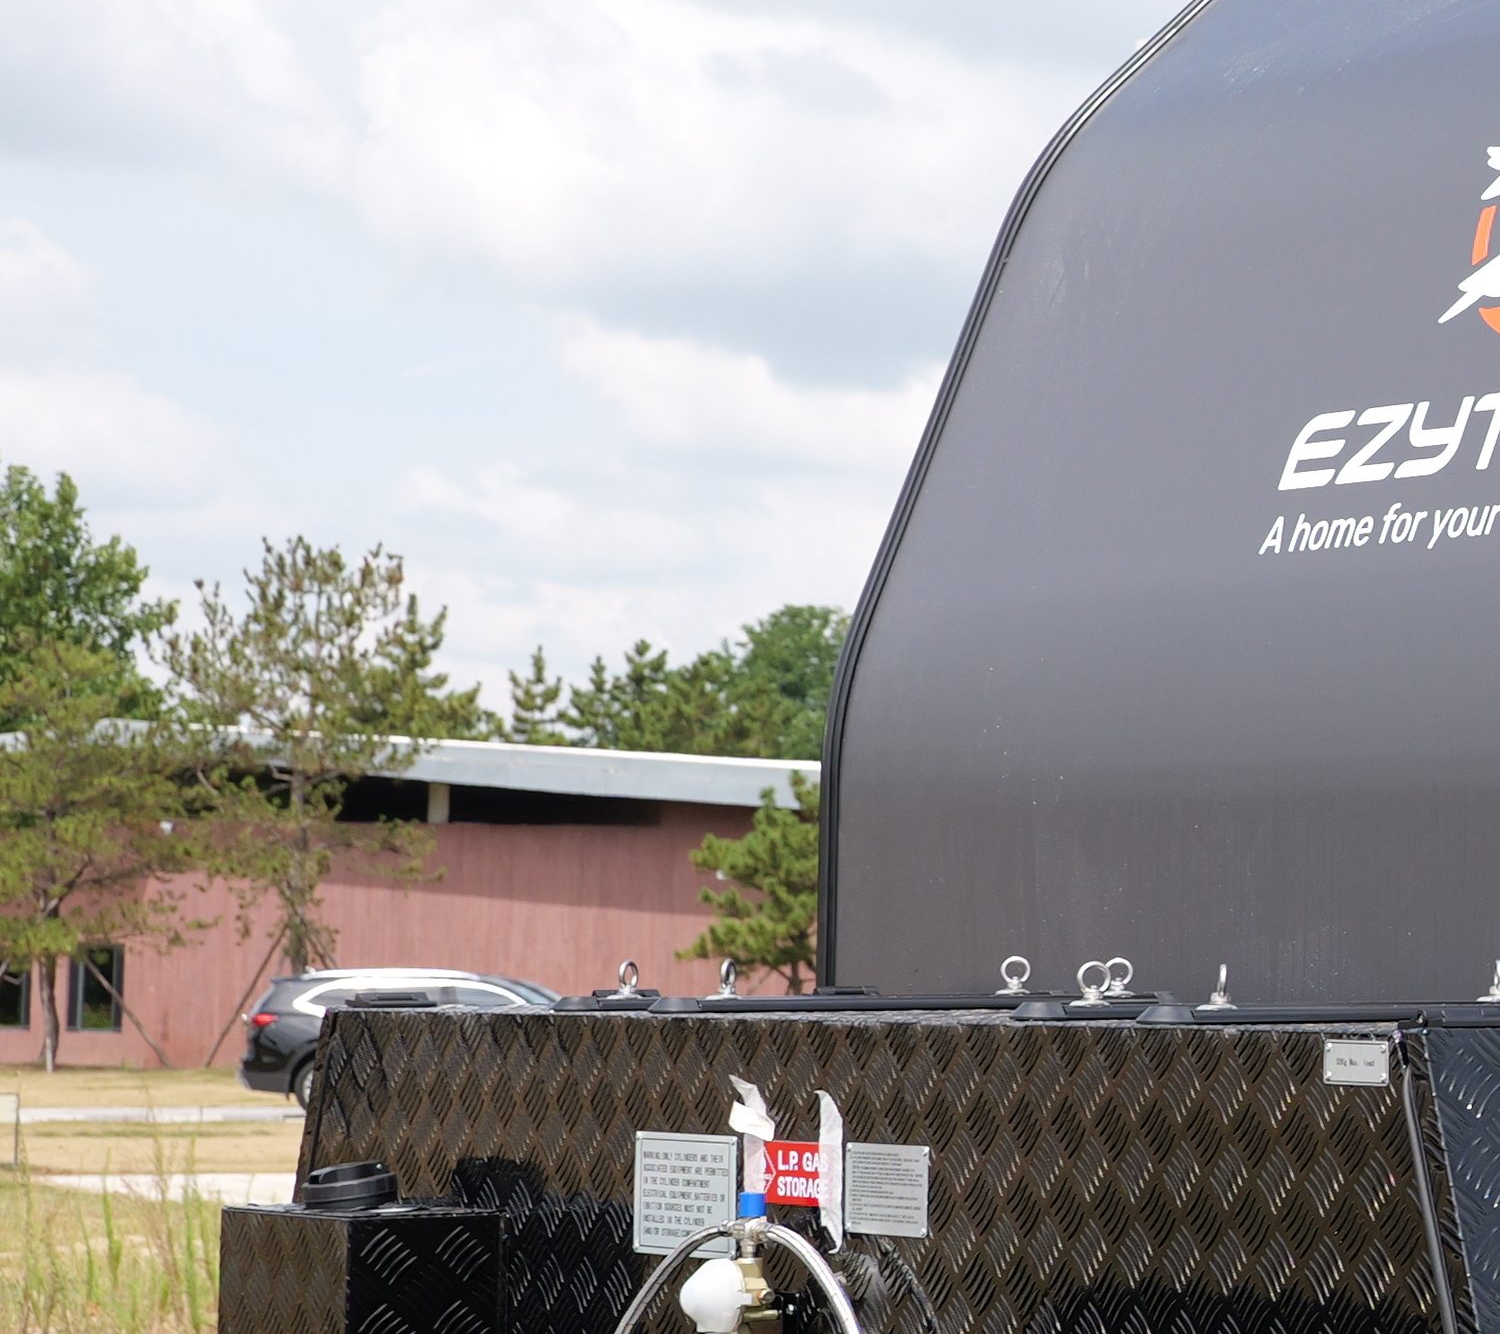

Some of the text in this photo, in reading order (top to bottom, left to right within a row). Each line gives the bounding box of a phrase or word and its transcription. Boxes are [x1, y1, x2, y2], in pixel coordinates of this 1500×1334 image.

[1259, 516, 1286, 556] A
[1288, 515, 1375, 554] home
[1379, 501, 1430, 545] for
[777, 1149, 799, 1171] L.P.
